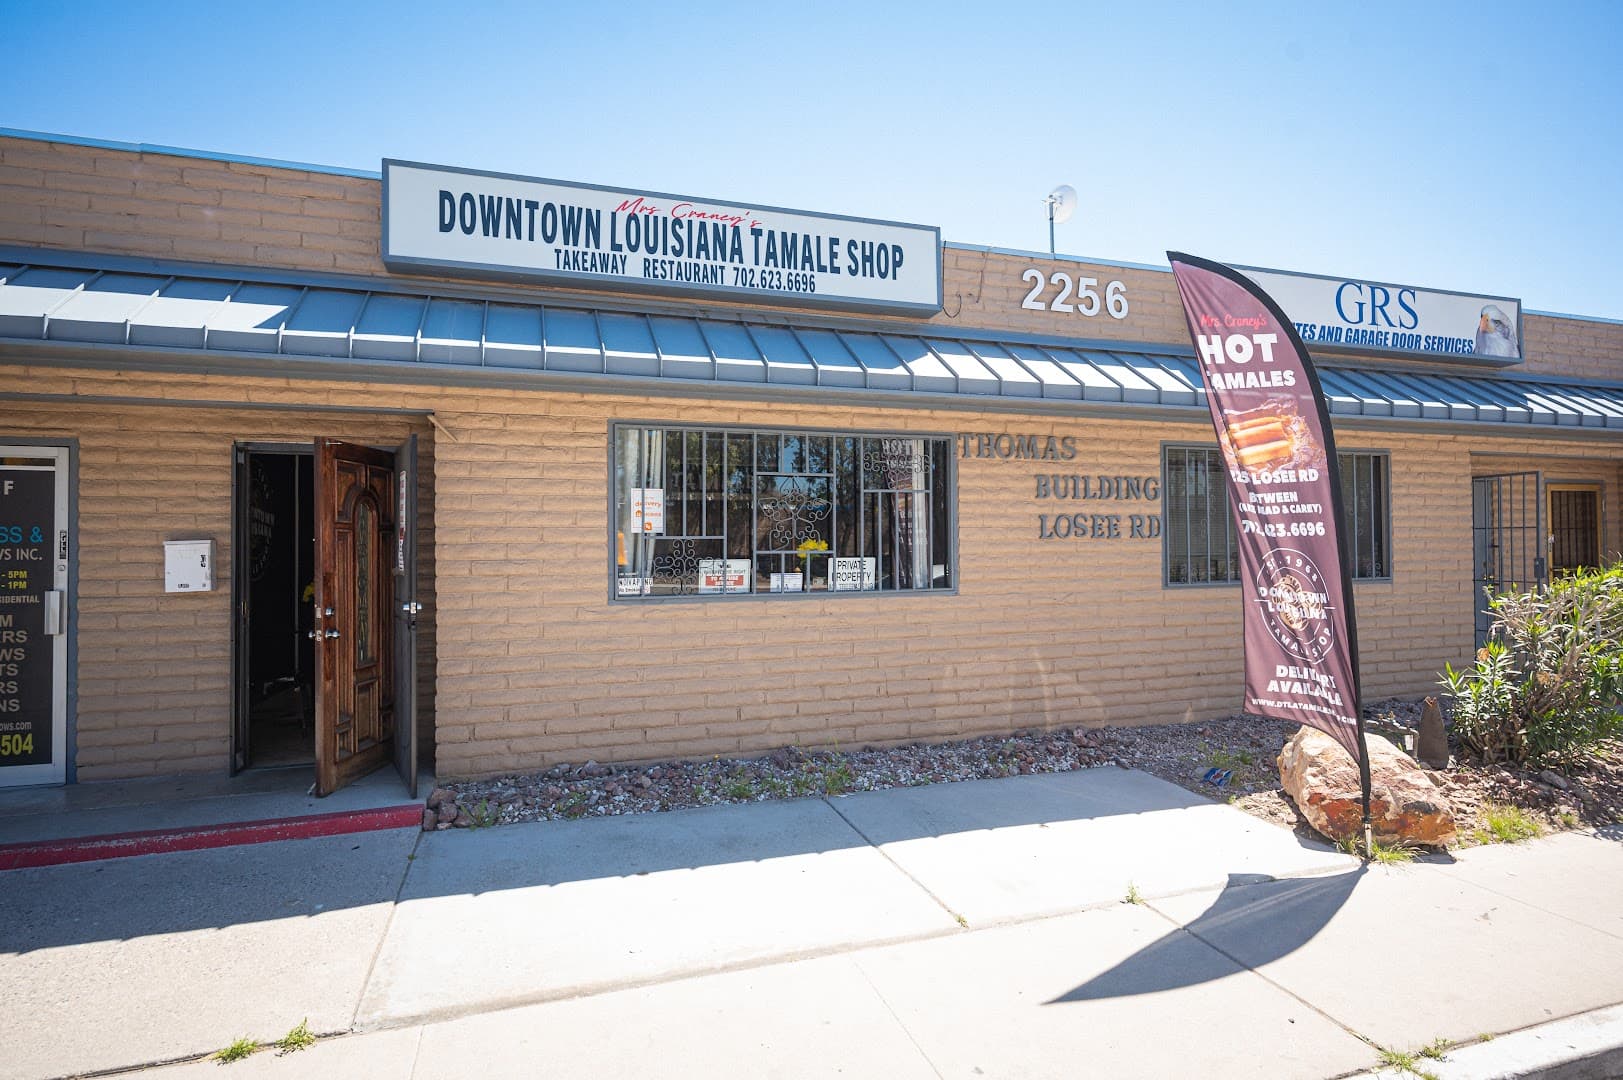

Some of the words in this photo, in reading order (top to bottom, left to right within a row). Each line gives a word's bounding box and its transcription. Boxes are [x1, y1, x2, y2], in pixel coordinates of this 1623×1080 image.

[615, 197, 661, 216] Mrs
[671, 203, 763, 228] Craney's
[439, 190, 601, 249] DOWNTOWN
[610, 211, 744, 264] LOUISIANA
[750, 227, 841, 275] TAMALE
[847, 239, 904, 280] SHOP
[554, 249, 627, 274] TAKEAWAY
[643, 257, 726, 285] RESTAURANT
[733, 266, 816, 293] 702.623.6696
[1021, 268, 1129, 319] 2256
[1335, 282, 1419, 330] GRS
[1198, 333, 1278, 365] HOT
[1293, 322, 1316, 340] TES
[1318, 325, 1343, 342] AND
[1345, 328, 1389, 347] GARAGE
[1391, 334, 1422, 350] DOOR
[1424, 336, 1474, 354] SERVICES
[1207, 369, 1296, 390] AMALES
[958, 432, 1077, 461] THOMAS
[3, 480, 14, 496] F
[1035, 474, 1161, 501] BUILDING
[1252, 469, 1297, 485] LOSEE
[1299, 469, 1319, 482] RD
[1249, 491, 1298, 504] BTWEEN
[30, 526, 43, 543] &
[1039, 514, 1121, 539] LOSEE
[1129, 515, 1162, 538] RD
[16, 548, 43, 561] INC.
[8, 570, 28, 579] 5PM
[8, 581, 27, 590] 1PM
[832, 572, 873, 582] ROPERTY
